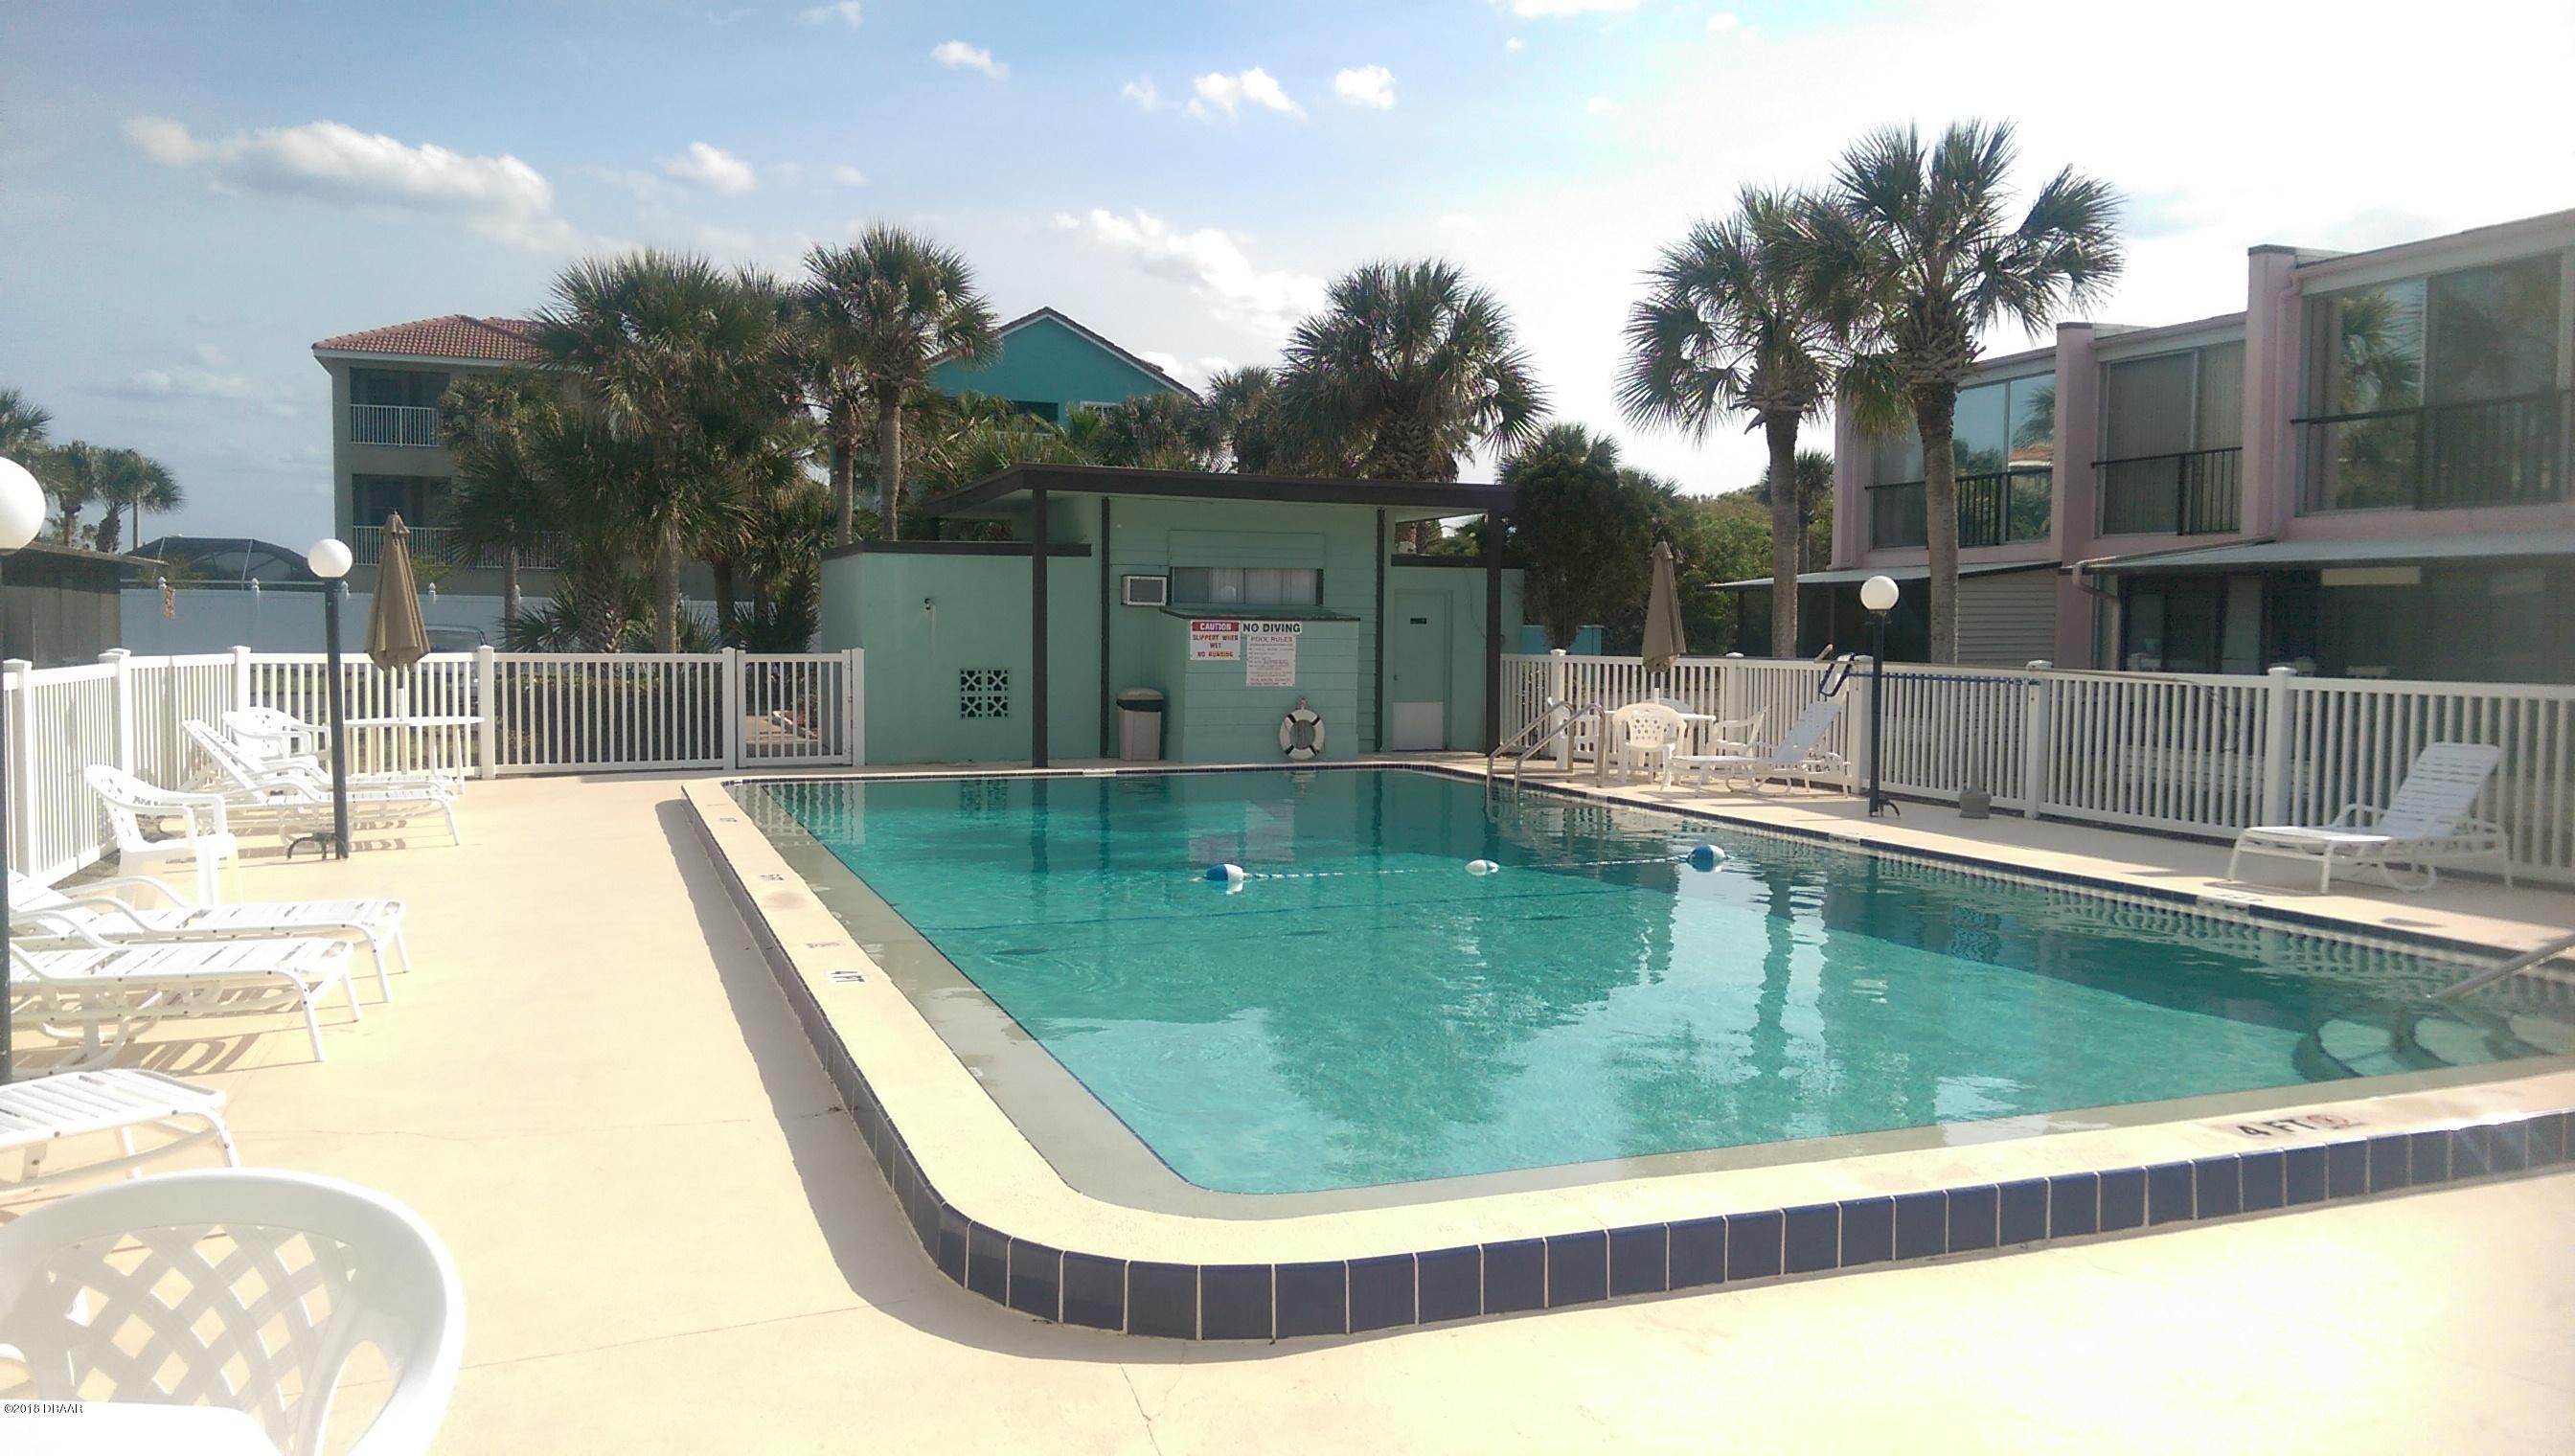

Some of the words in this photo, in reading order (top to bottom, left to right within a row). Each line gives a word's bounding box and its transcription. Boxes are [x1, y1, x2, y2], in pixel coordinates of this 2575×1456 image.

[1242, 623, 1260, 633] NO
[1263, 623, 1301, 633] DIVING
[2238, 1125, 2273, 1136] 4
[2260, 1118, 2317, 1133] FT
